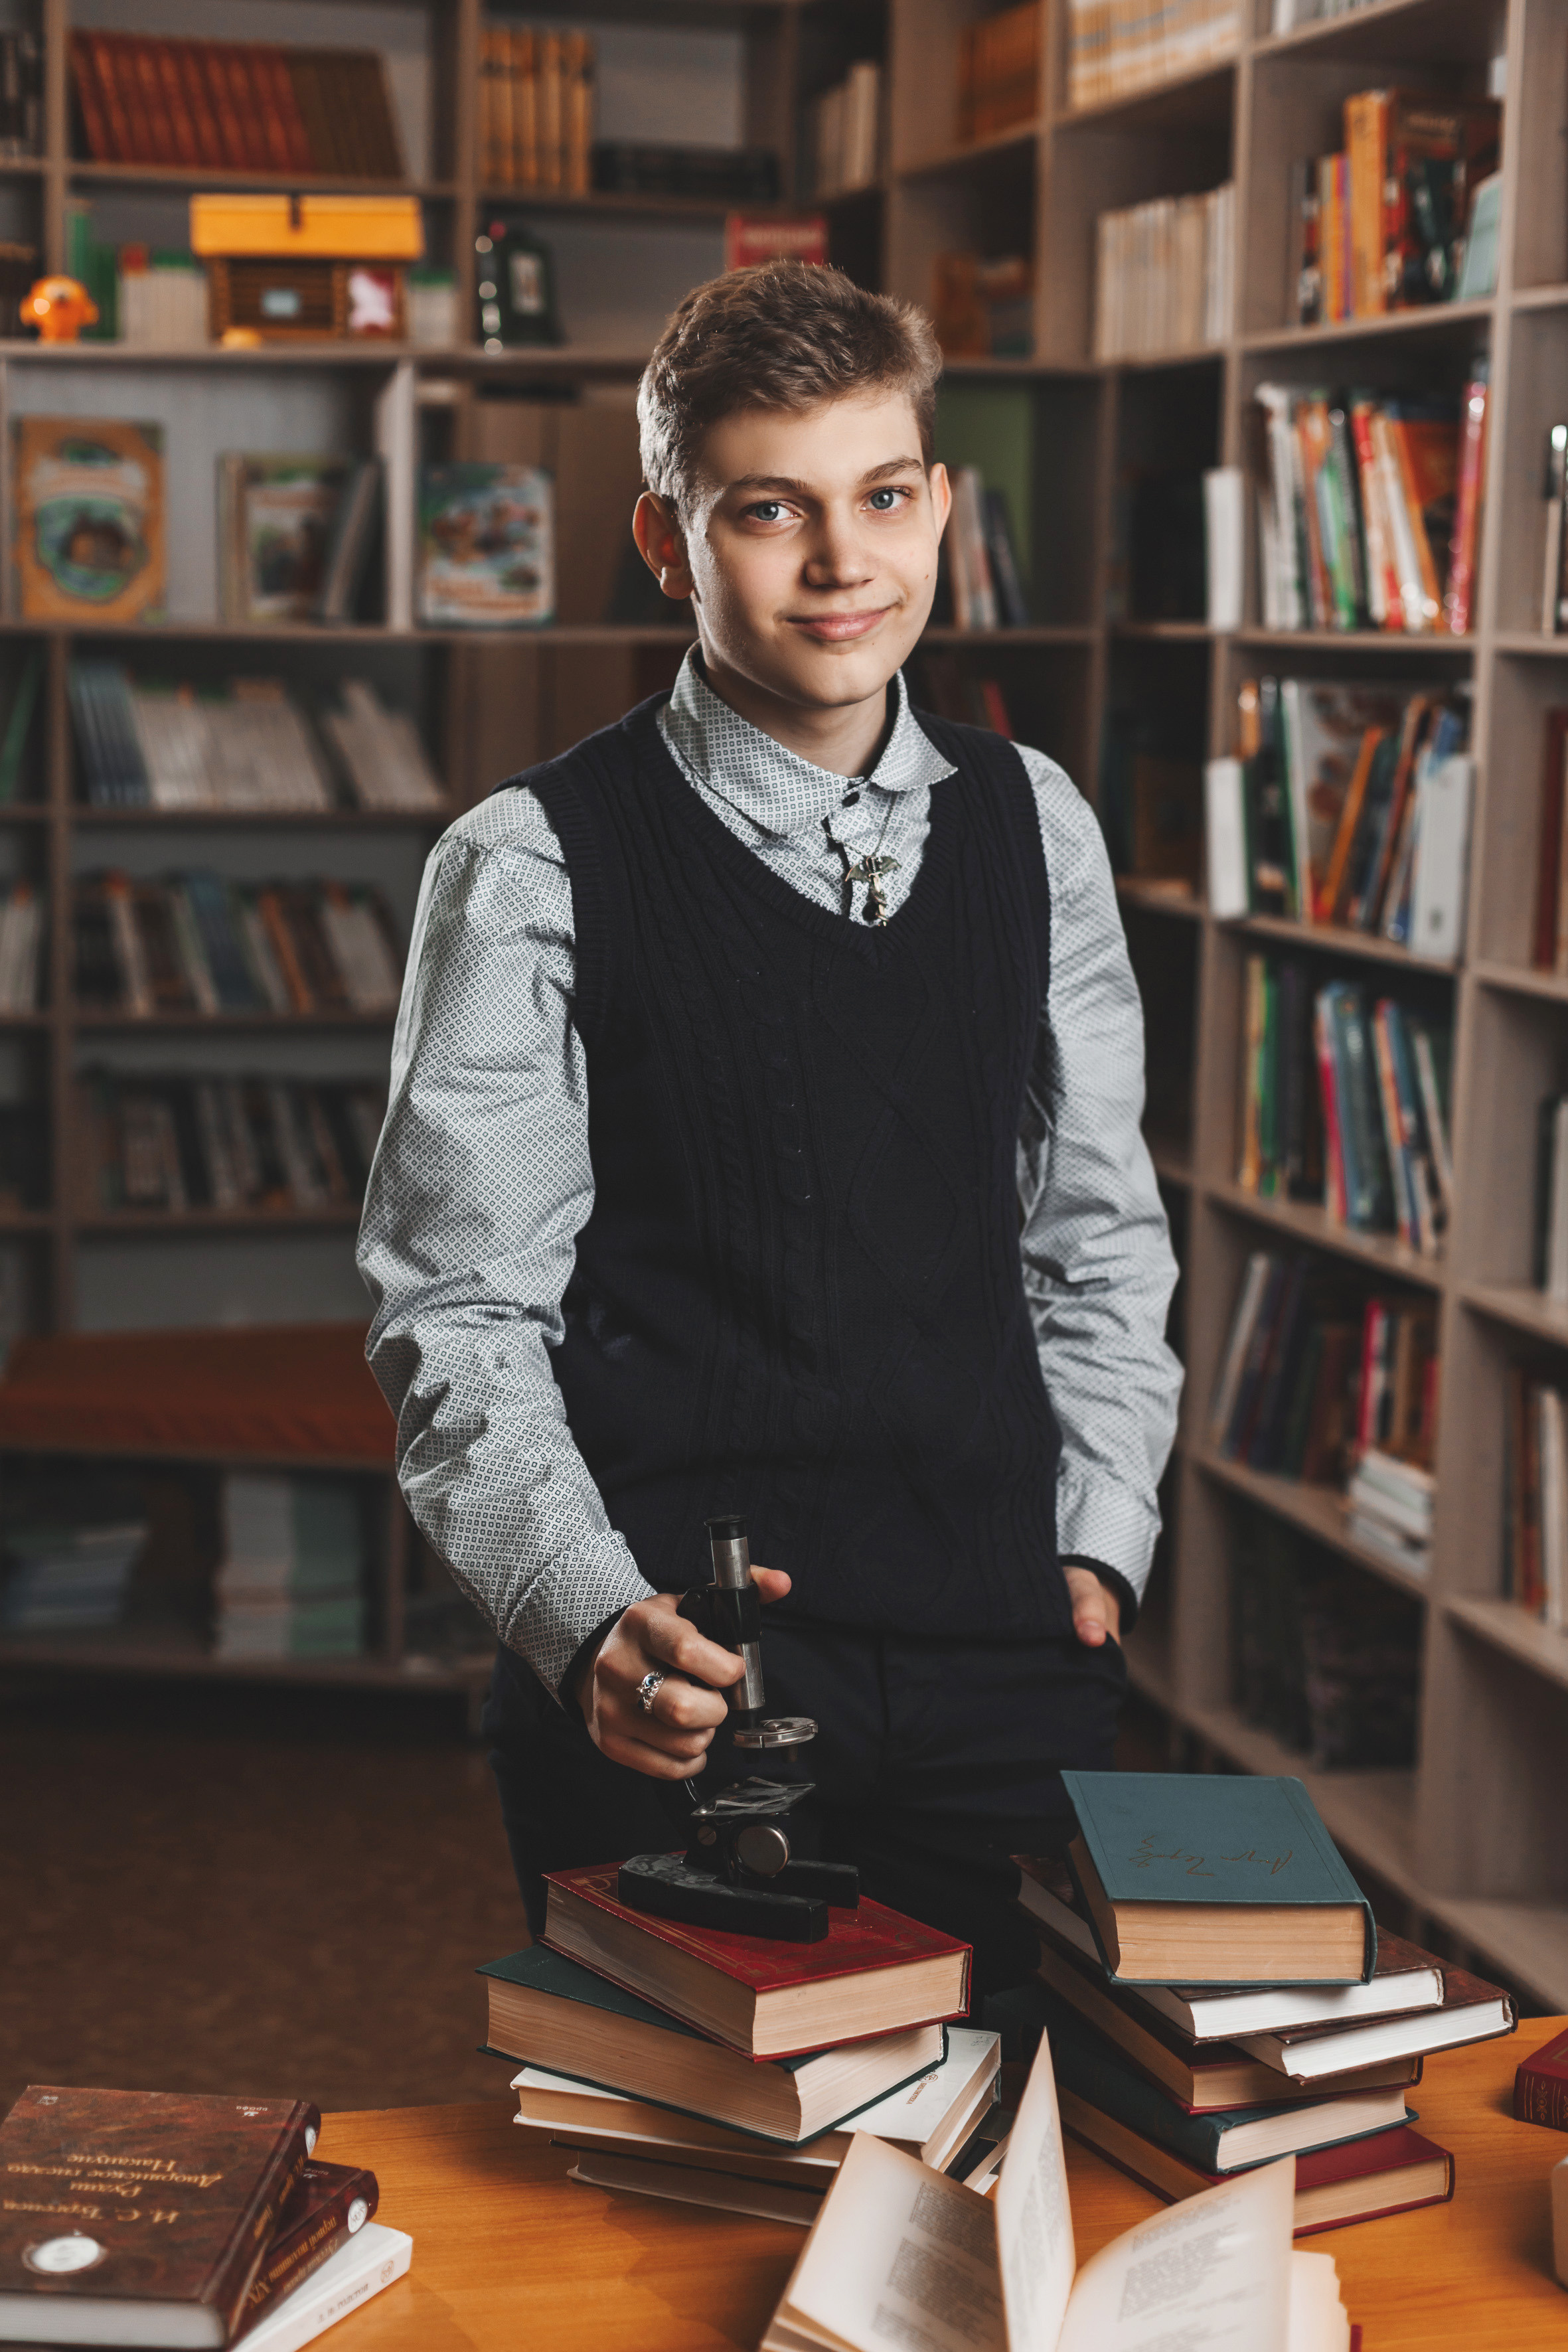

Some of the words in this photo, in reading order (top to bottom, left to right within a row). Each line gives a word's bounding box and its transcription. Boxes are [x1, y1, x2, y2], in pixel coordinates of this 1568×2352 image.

[7, 2162, 82, 2177] гнездо
[67, 2154, 177, 2171] Накануне
[87, 2169, 224, 2187] Дворянское
[69, 2181, 143, 2198] Рудин
[3, 2199, 105, 2219] Тургенев
